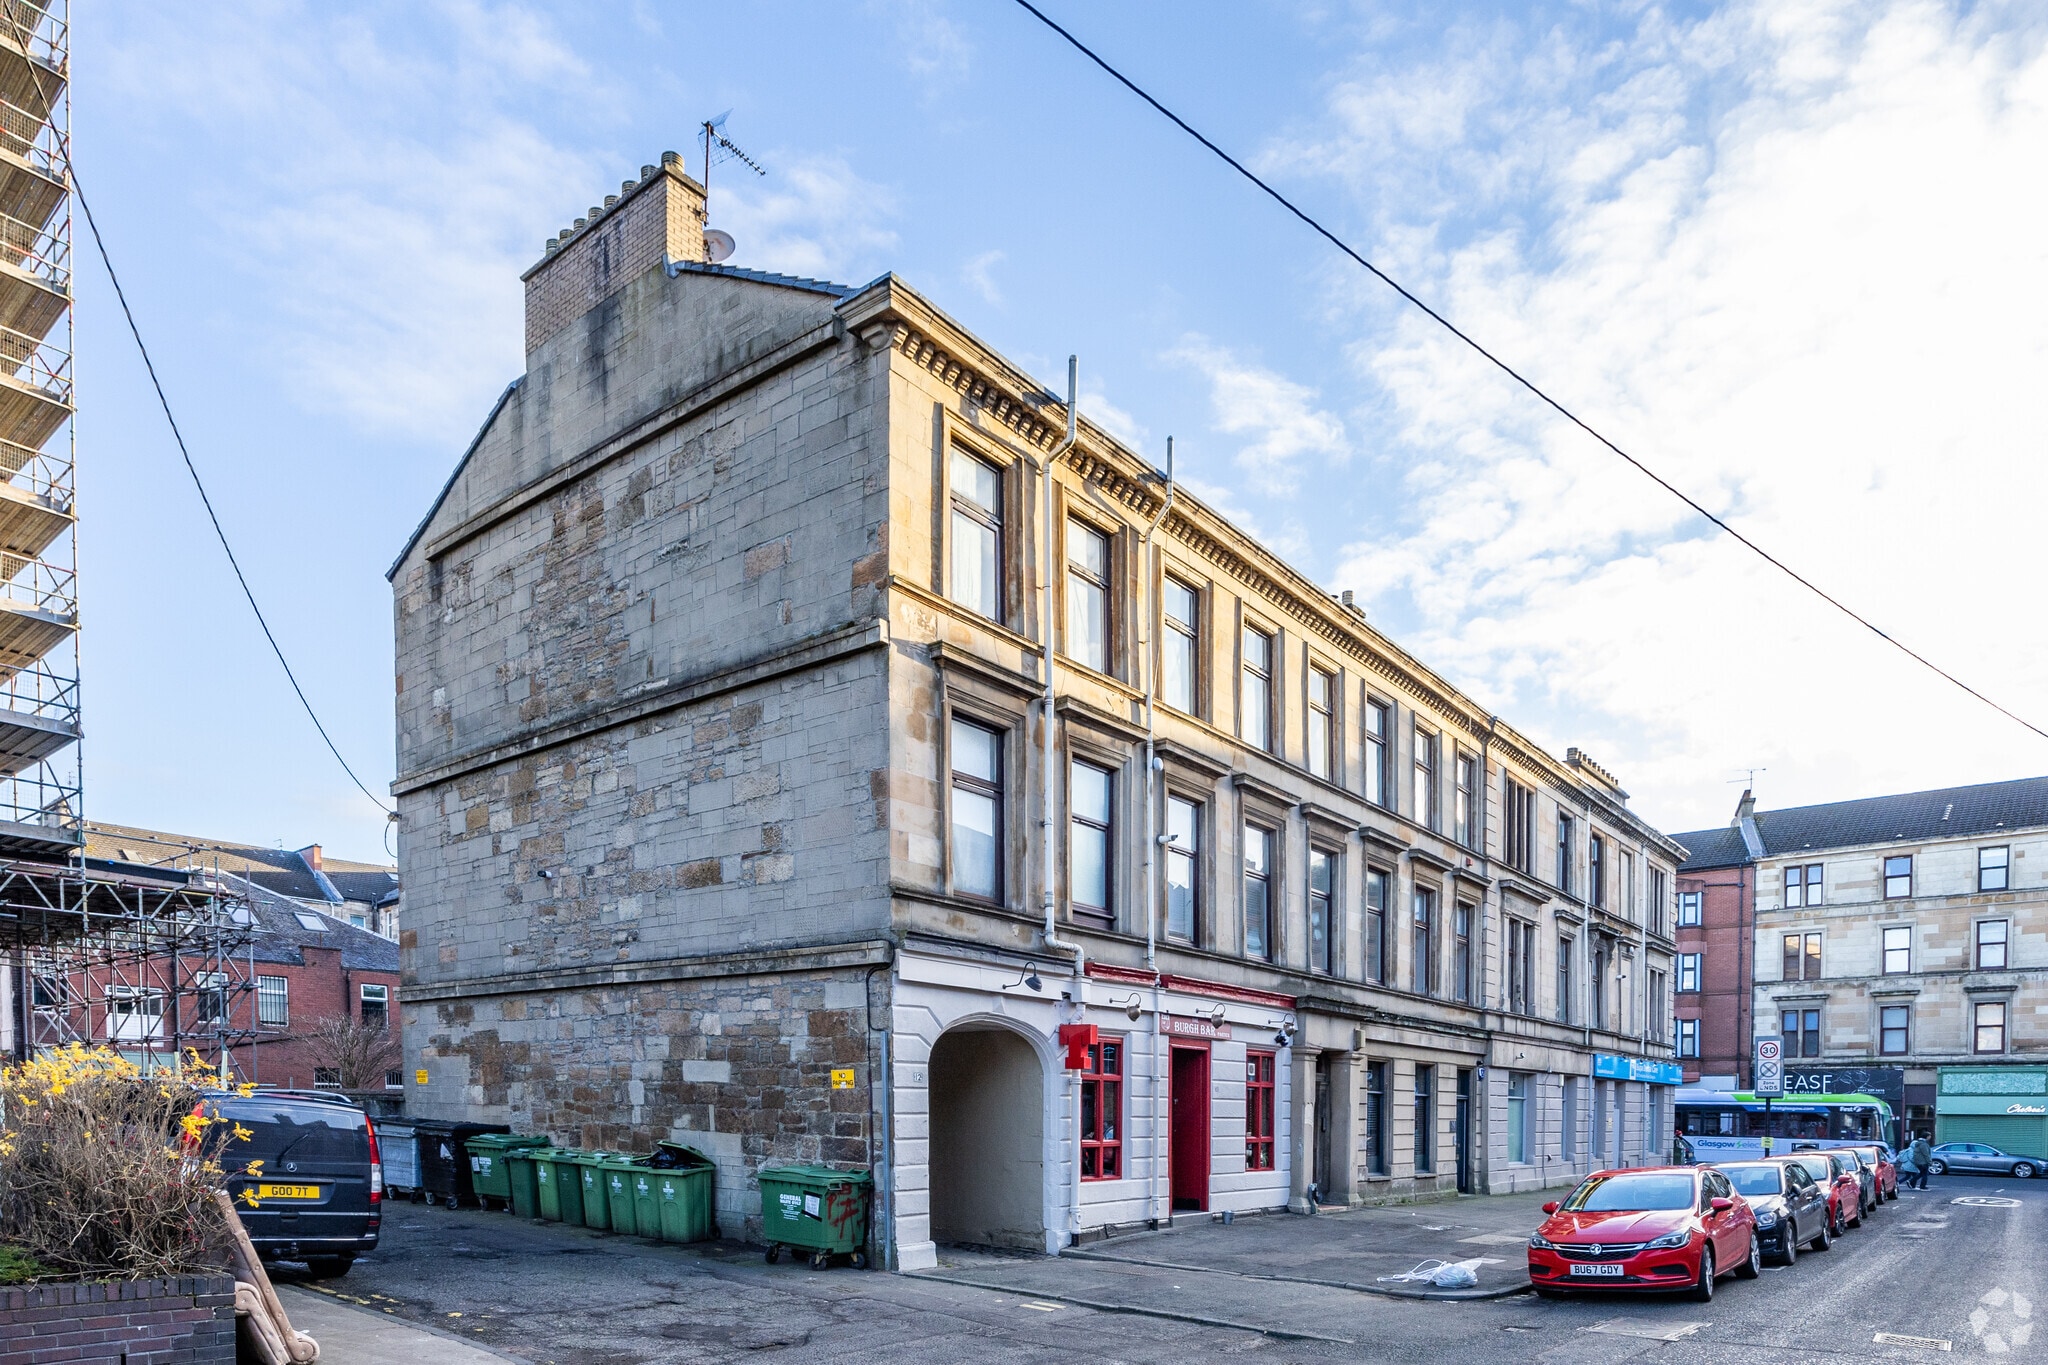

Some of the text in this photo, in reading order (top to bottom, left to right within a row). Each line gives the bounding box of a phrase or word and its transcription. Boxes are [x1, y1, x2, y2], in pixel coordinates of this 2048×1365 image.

[1174, 1021, 1199, 1034] BURGH
[1200, 1024, 1216, 1036] BAR
[1762, 1046, 1776, 1054] 30
[1698, 1139, 1735, 1149] Glasgow
[295, 1187, 309, 1197] 7T
[1574, 1265, 1619, 1275] BU67 GDY
